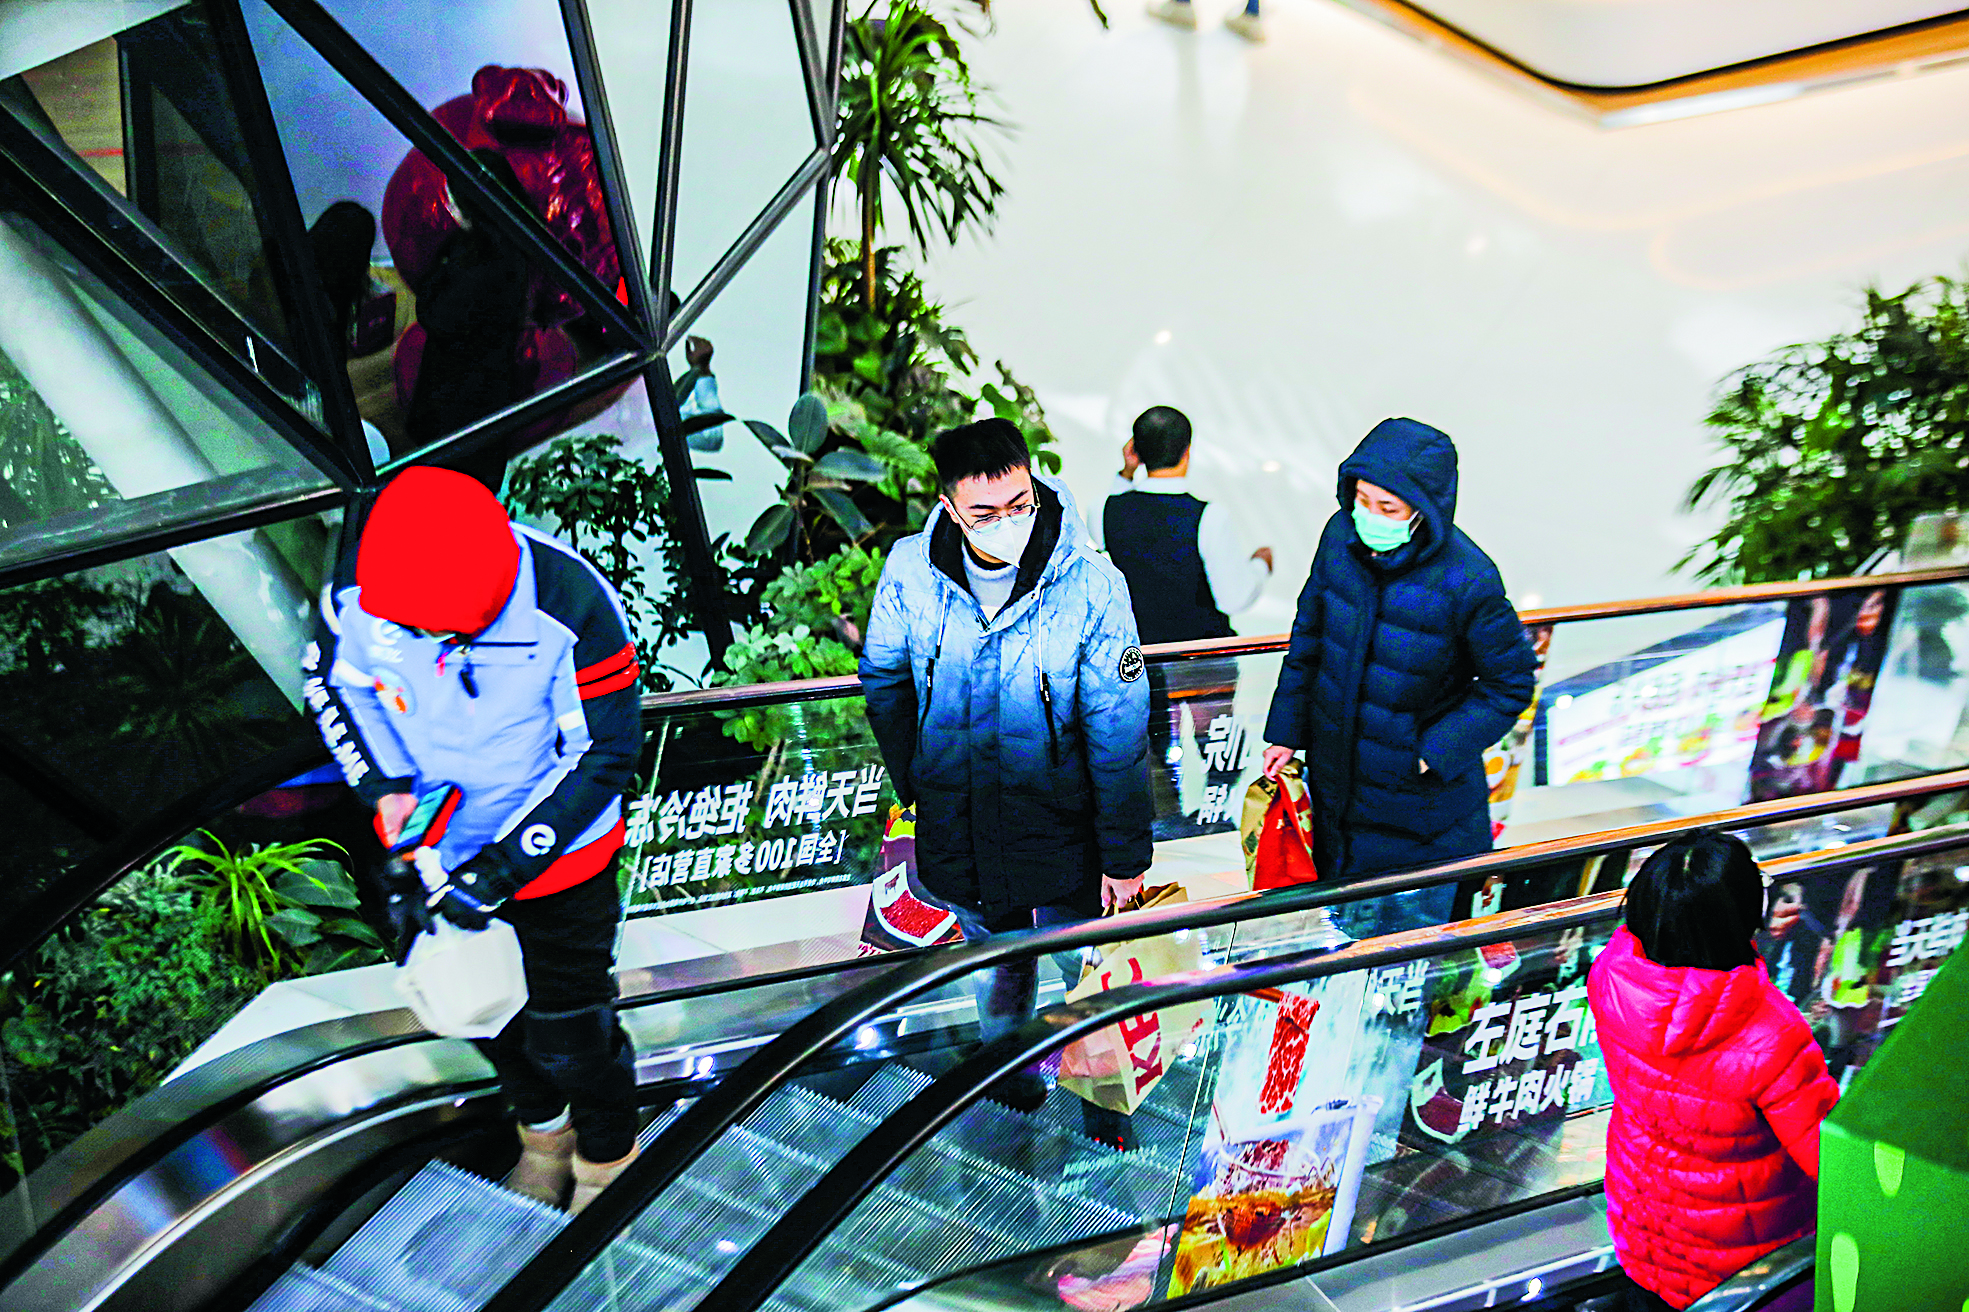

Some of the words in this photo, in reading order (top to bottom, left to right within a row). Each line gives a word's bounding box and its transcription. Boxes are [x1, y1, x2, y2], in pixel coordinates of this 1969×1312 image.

[1457, 1057, 1600, 1133] 鲜牛肉火锅
